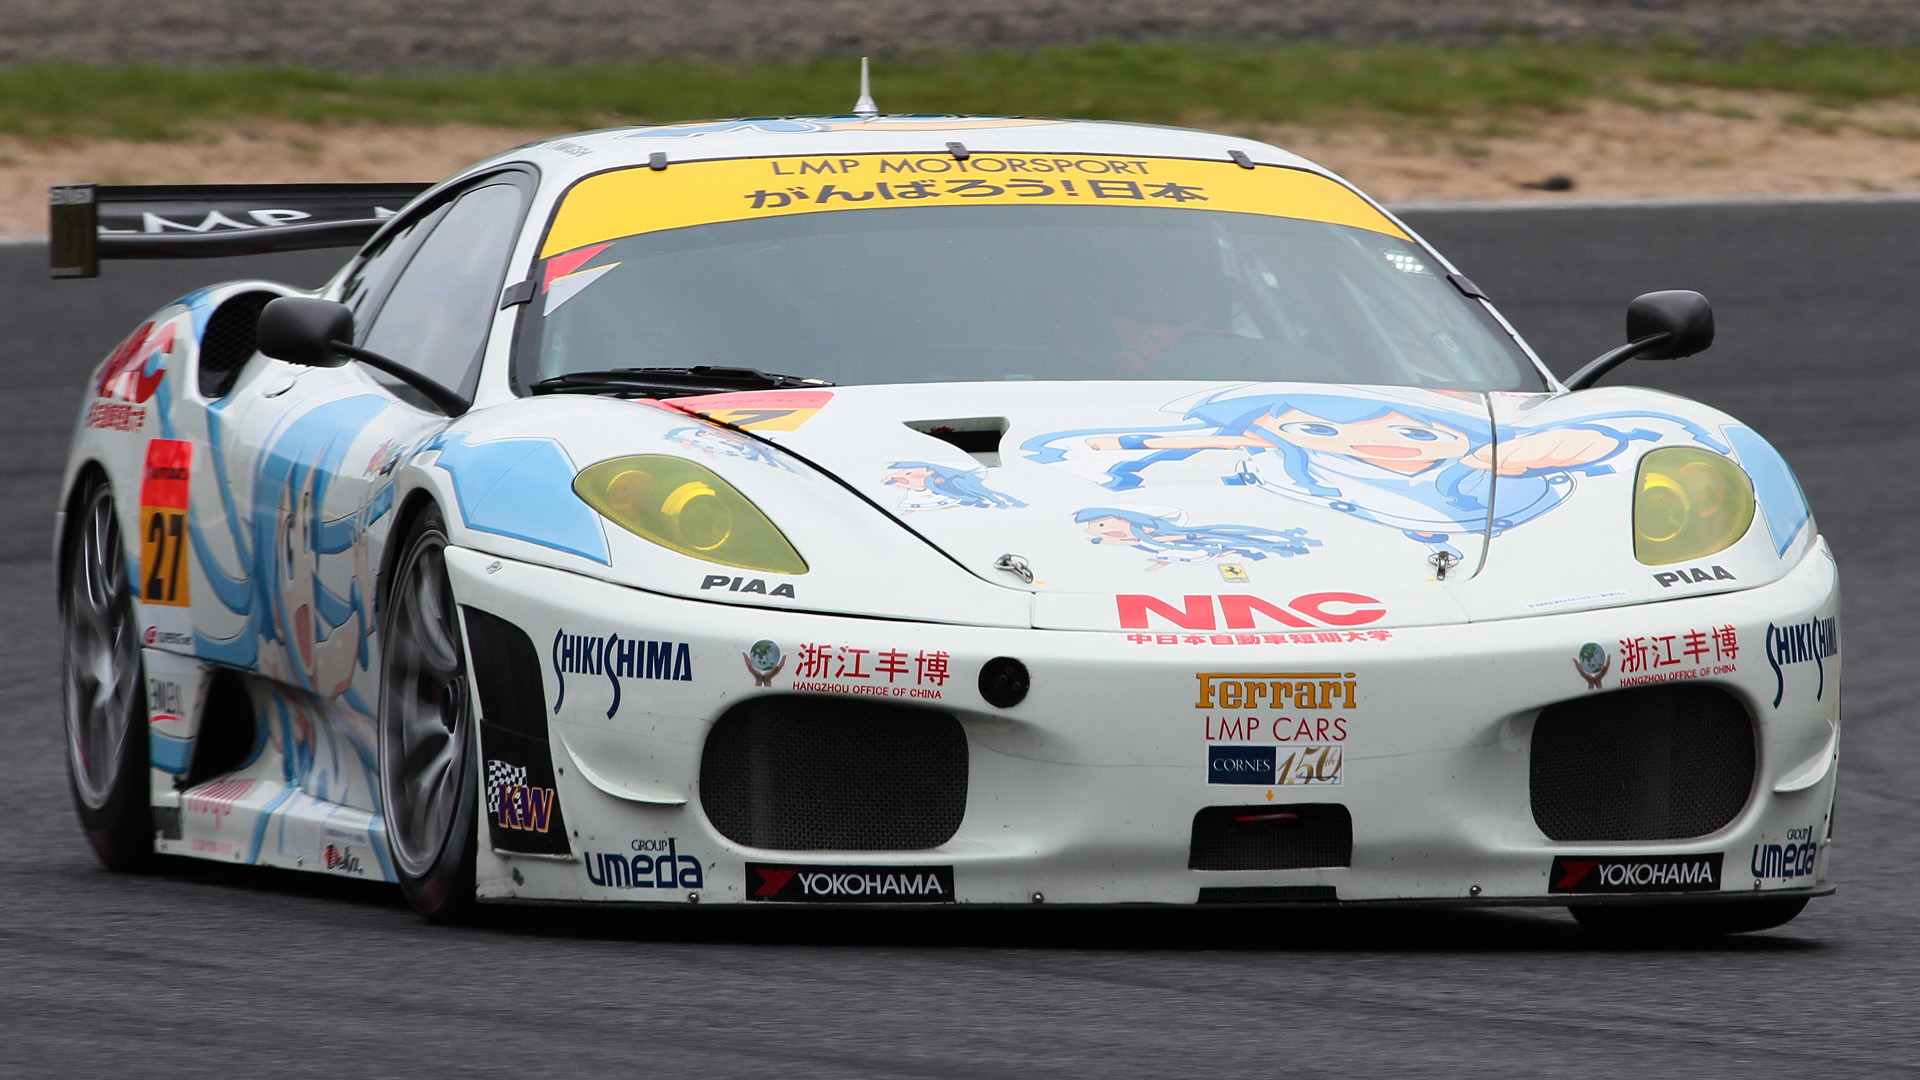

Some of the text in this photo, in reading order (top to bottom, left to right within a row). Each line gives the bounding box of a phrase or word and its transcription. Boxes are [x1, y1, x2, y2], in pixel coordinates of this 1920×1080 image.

[771, 158, 1150, 176] LMP MOTORSPORT
[147, 512, 184, 601] 27
[700, 574, 796, 599] PIAA
[1652, 565, 1738, 588] PIAA
[1115, 592, 1387, 630] NAC
[1126, 629, 1394, 646] 中日本自動車短期大学
[1619, 624, 1740, 673] 浙江丰博
[552, 627, 693, 720] SHIKISHIMA
[795, 643, 951, 687] 浙江丰博
[1620, 663, 1737, 687] HANGZHOU OFFICE OF CHINA
[792, 681, 942, 699] HANGZHOU OFFICE OF CHINA
[1195, 672, 1357, 709] Ferrari
[1205, 716, 1348, 742] LMP CARS
[1213, 758, 1271, 772] CORNES
[498, 783, 554, 833] KW
[631, 839, 668, 851] GROUP
[1787, 828, 1808, 840] GROUP
[584, 837, 703, 888] umeda
[1598, 861, 1714, 886] YOKOHAMA
[798, 873, 943, 895] YOKOHAMA
